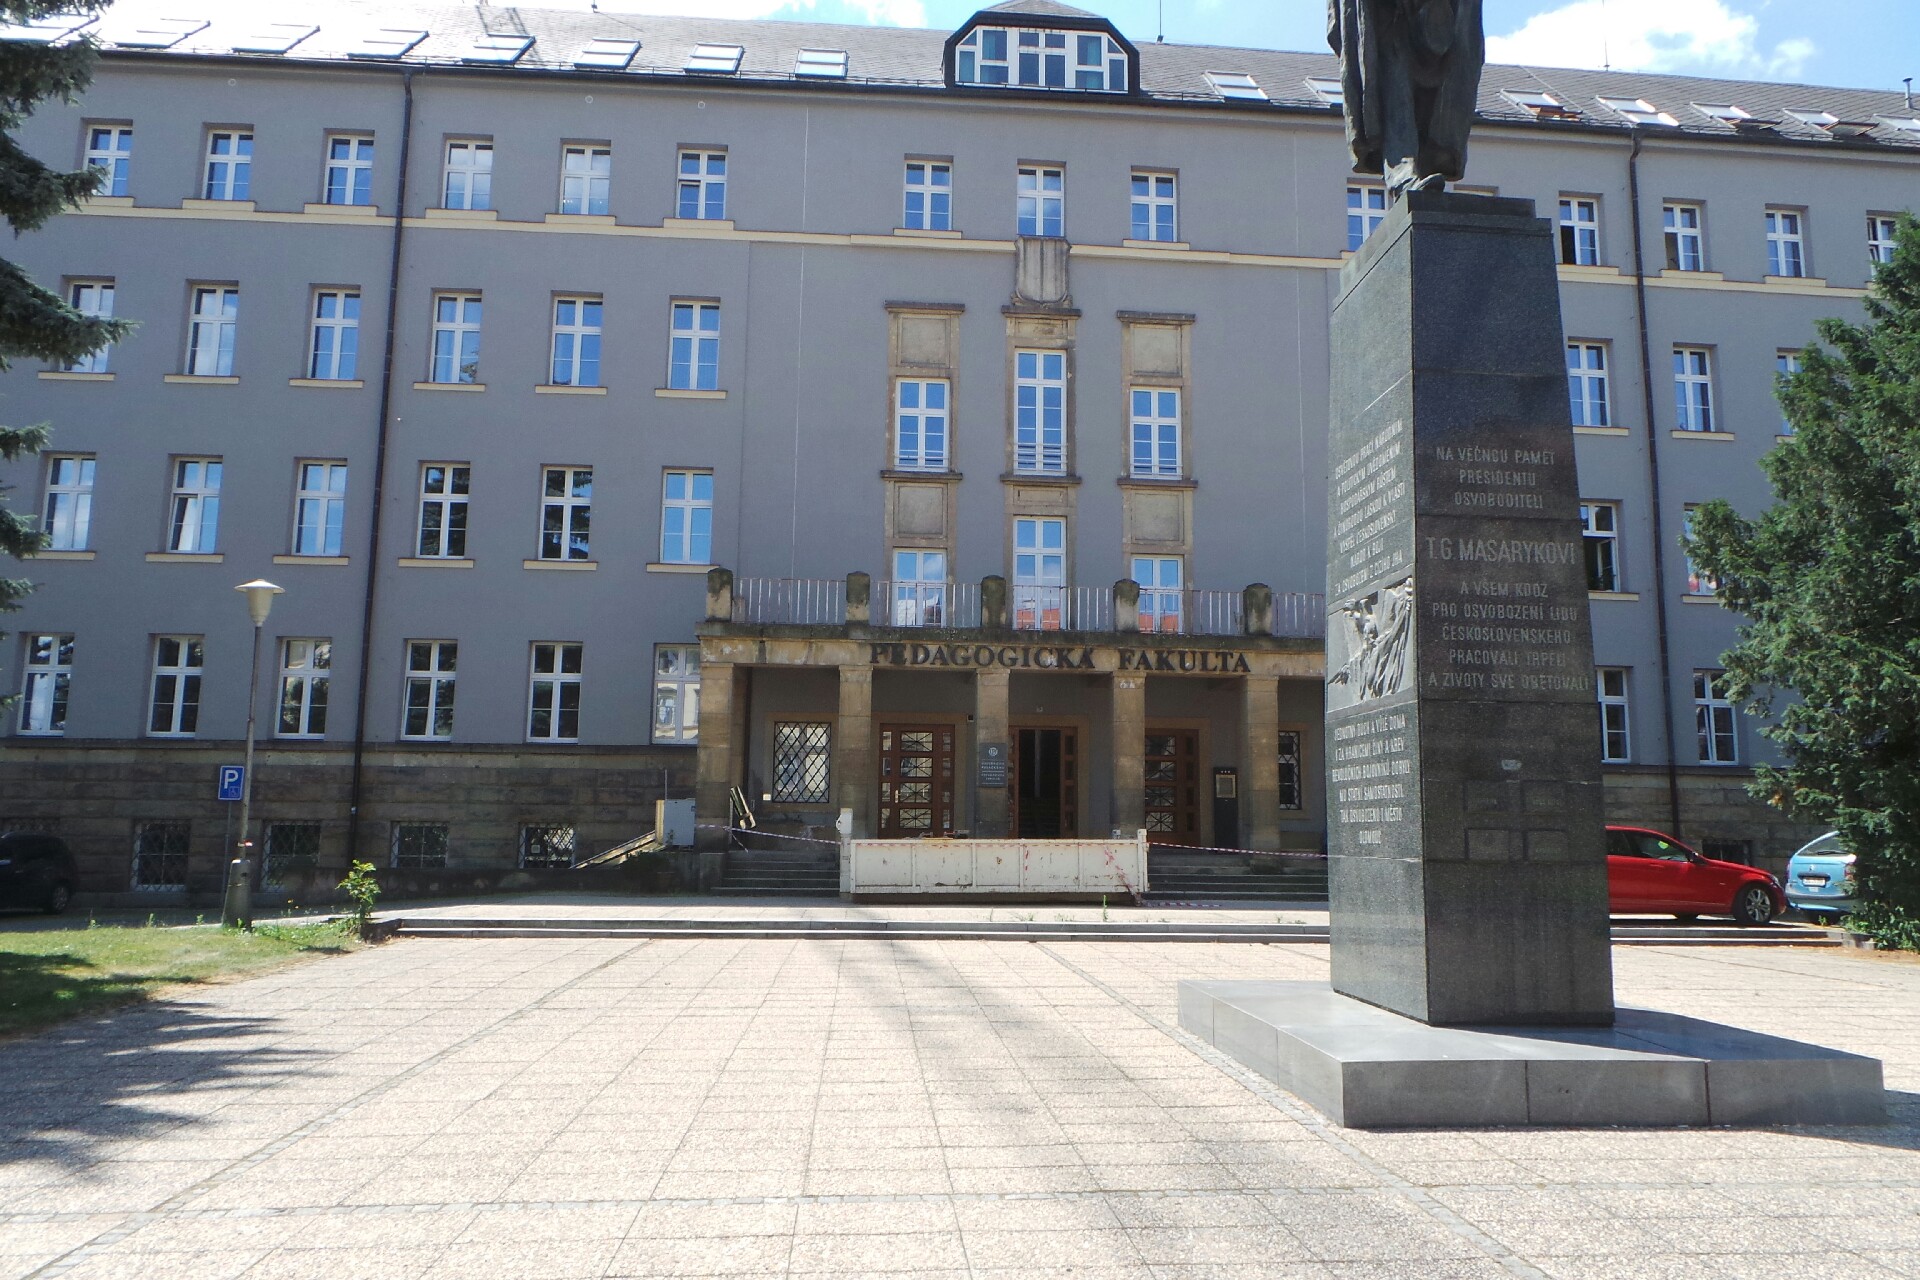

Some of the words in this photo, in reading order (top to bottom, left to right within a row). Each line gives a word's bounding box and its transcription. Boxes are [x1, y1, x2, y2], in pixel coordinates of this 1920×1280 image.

[1436, 446, 1454, 461] NA
[1459, 469, 1536, 486] PRESIDENTU
[1454, 491, 1544, 509] OSVOBODITELI
[1459, 538, 1576, 565] MASARYKOVI
[1460, 581, 1469, 595] A
[1432, 602, 1457, 617] PRO
[1118, 649, 1251, 673] FAKULTA
[1449, 649, 1518, 665] PRACOVALI
[1428, 671, 1438, 687] A
[224, 769, 239, 789] P
